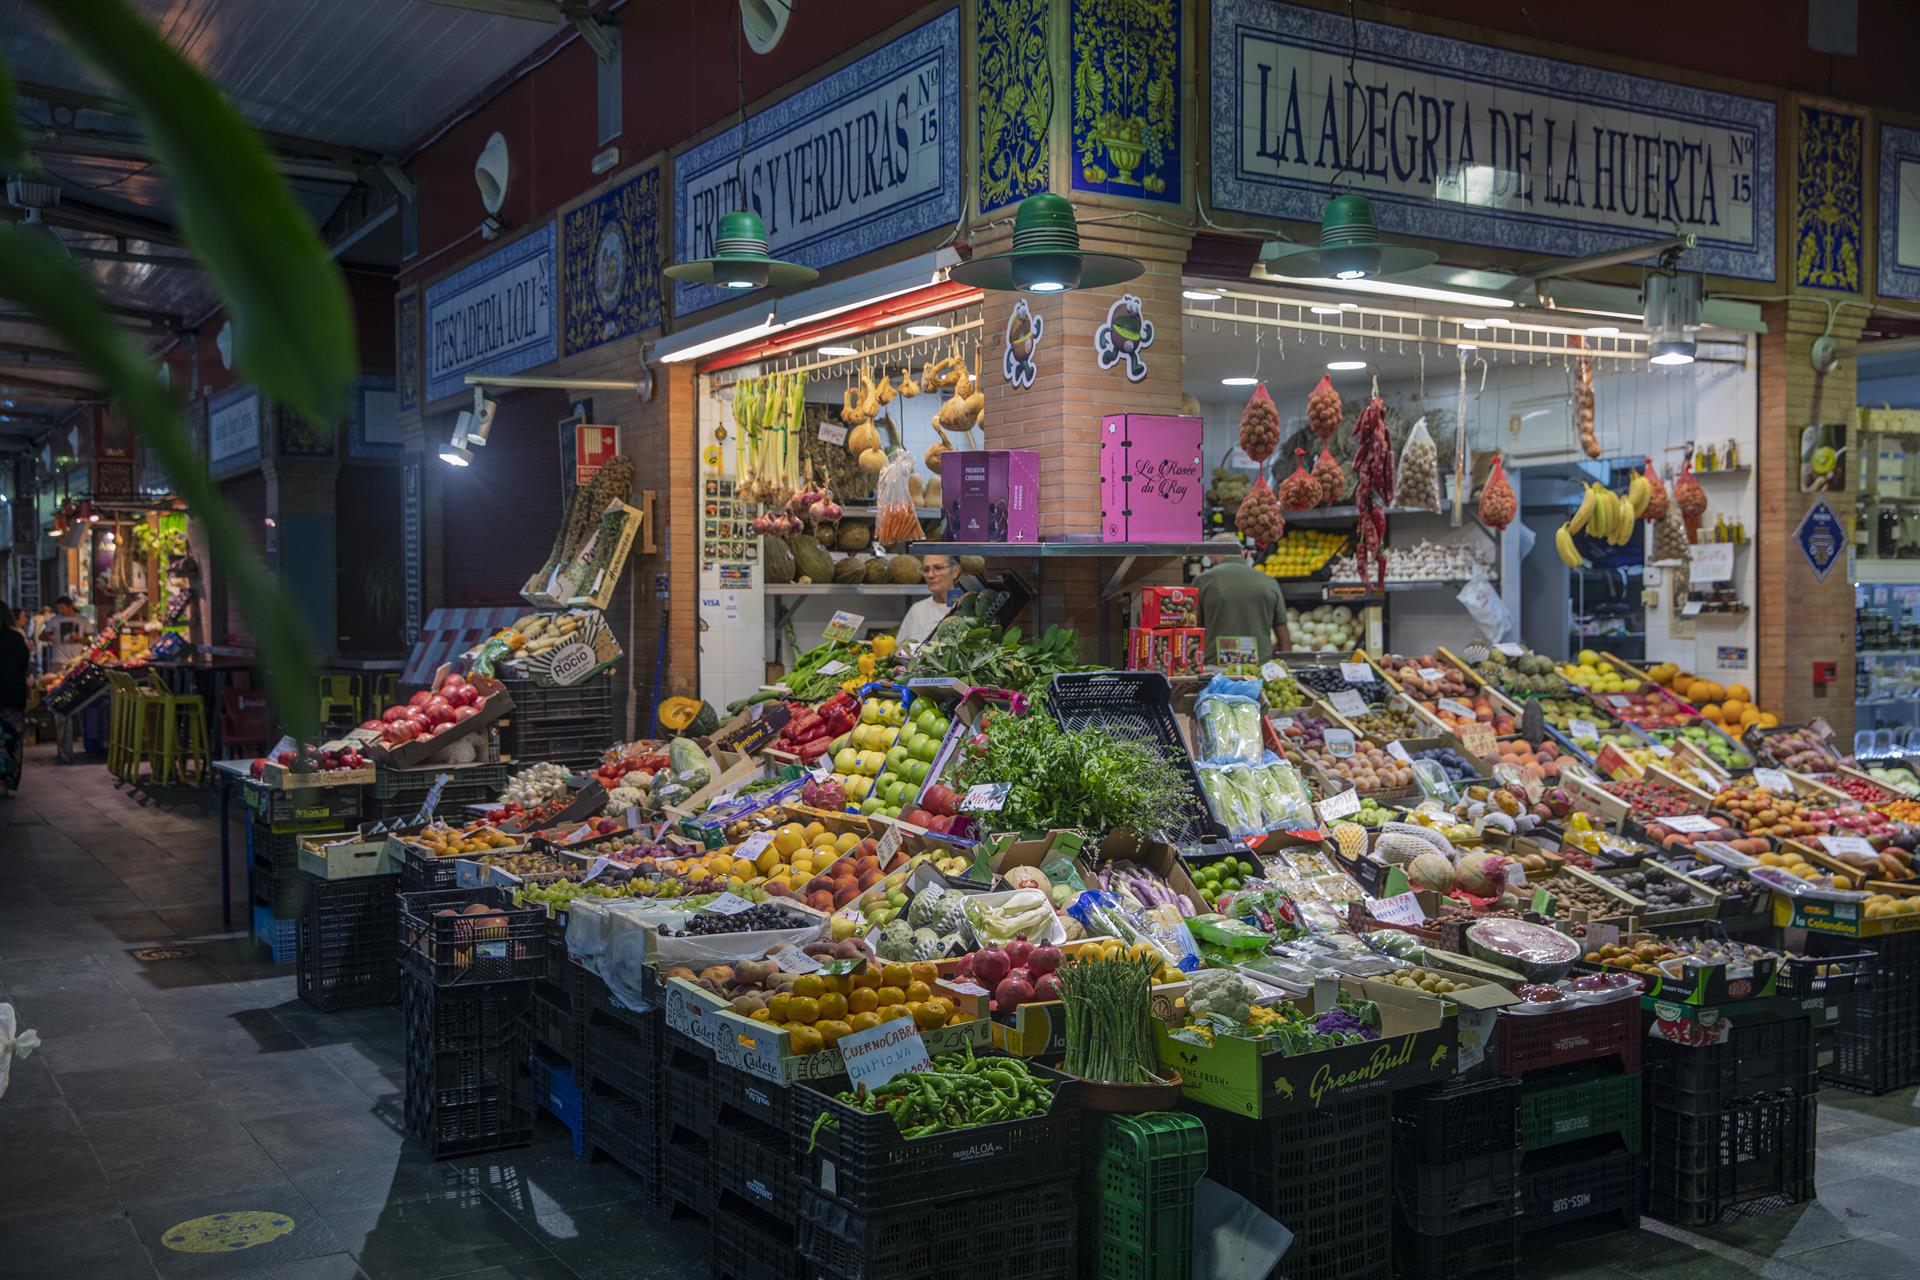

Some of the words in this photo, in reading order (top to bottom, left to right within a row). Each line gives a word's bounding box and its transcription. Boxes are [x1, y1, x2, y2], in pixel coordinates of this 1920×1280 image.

[919, 110, 938, 146] 15
[1257, 63, 1308, 168] LA
[1314, 74, 1478, 186] ALEGRIA
[1488, 108, 1533, 206] DE
[1543, 118, 1585, 208] LA
[1592, 126, 1720, 226] HUERTA
[767, 155, 781, 236] Y
[784, 85, 910, 229] VERDURAS
[1731, 174, 1751, 203] 15
[434, 292, 503, 372] PESCADERIA
[506, 277, 537, 344] LOLI
[1141, 479, 1154, 494] du
[1158, 480, 1188, 504] Roy
[703, 599, 720, 607] VISA
[1807, 917, 1856, 934] Calandina
[690, 1020, 715, 1043] Cadet
[743, 1052, 778, 1076] Cadete
[1182, 1067, 1198, 1078] THE
[1200, 1072, 1225, 1085] FRESH
[1309, 1033, 1418, 1109] GreenBull
[1341, 1085, 1357, 1094] ENJOY
[969, 1142, 994, 1155] ALOA
[1552, 1193, 1591, 1213] MISS-SUR
